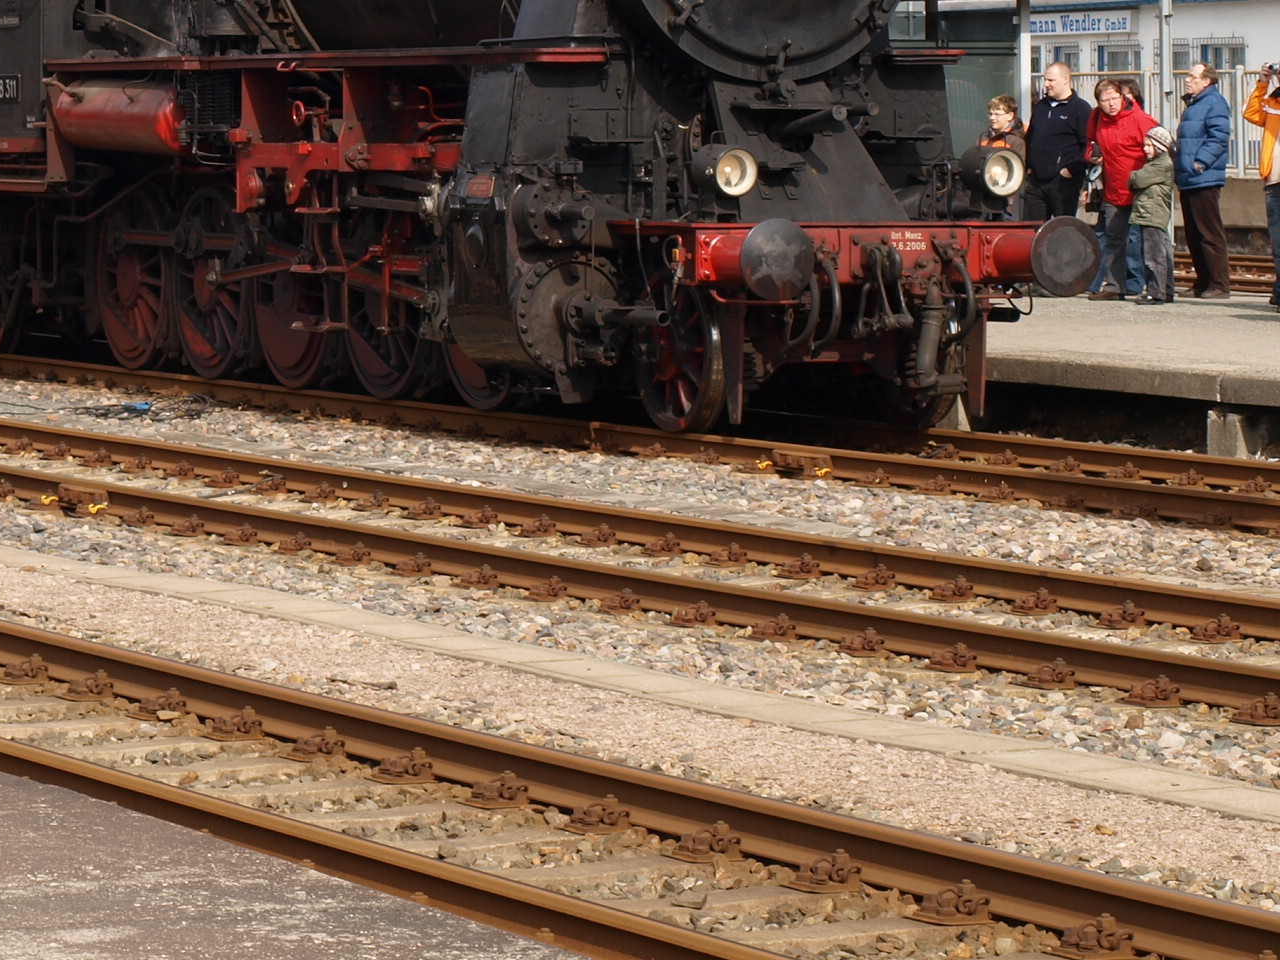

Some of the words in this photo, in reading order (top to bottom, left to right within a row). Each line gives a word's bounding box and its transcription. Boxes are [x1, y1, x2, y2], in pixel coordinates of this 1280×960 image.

[1060, 14, 1101, 33] Wendler
[1104, 17, 1128, 31] GmbH
[5, 79, 17, 98] 311
